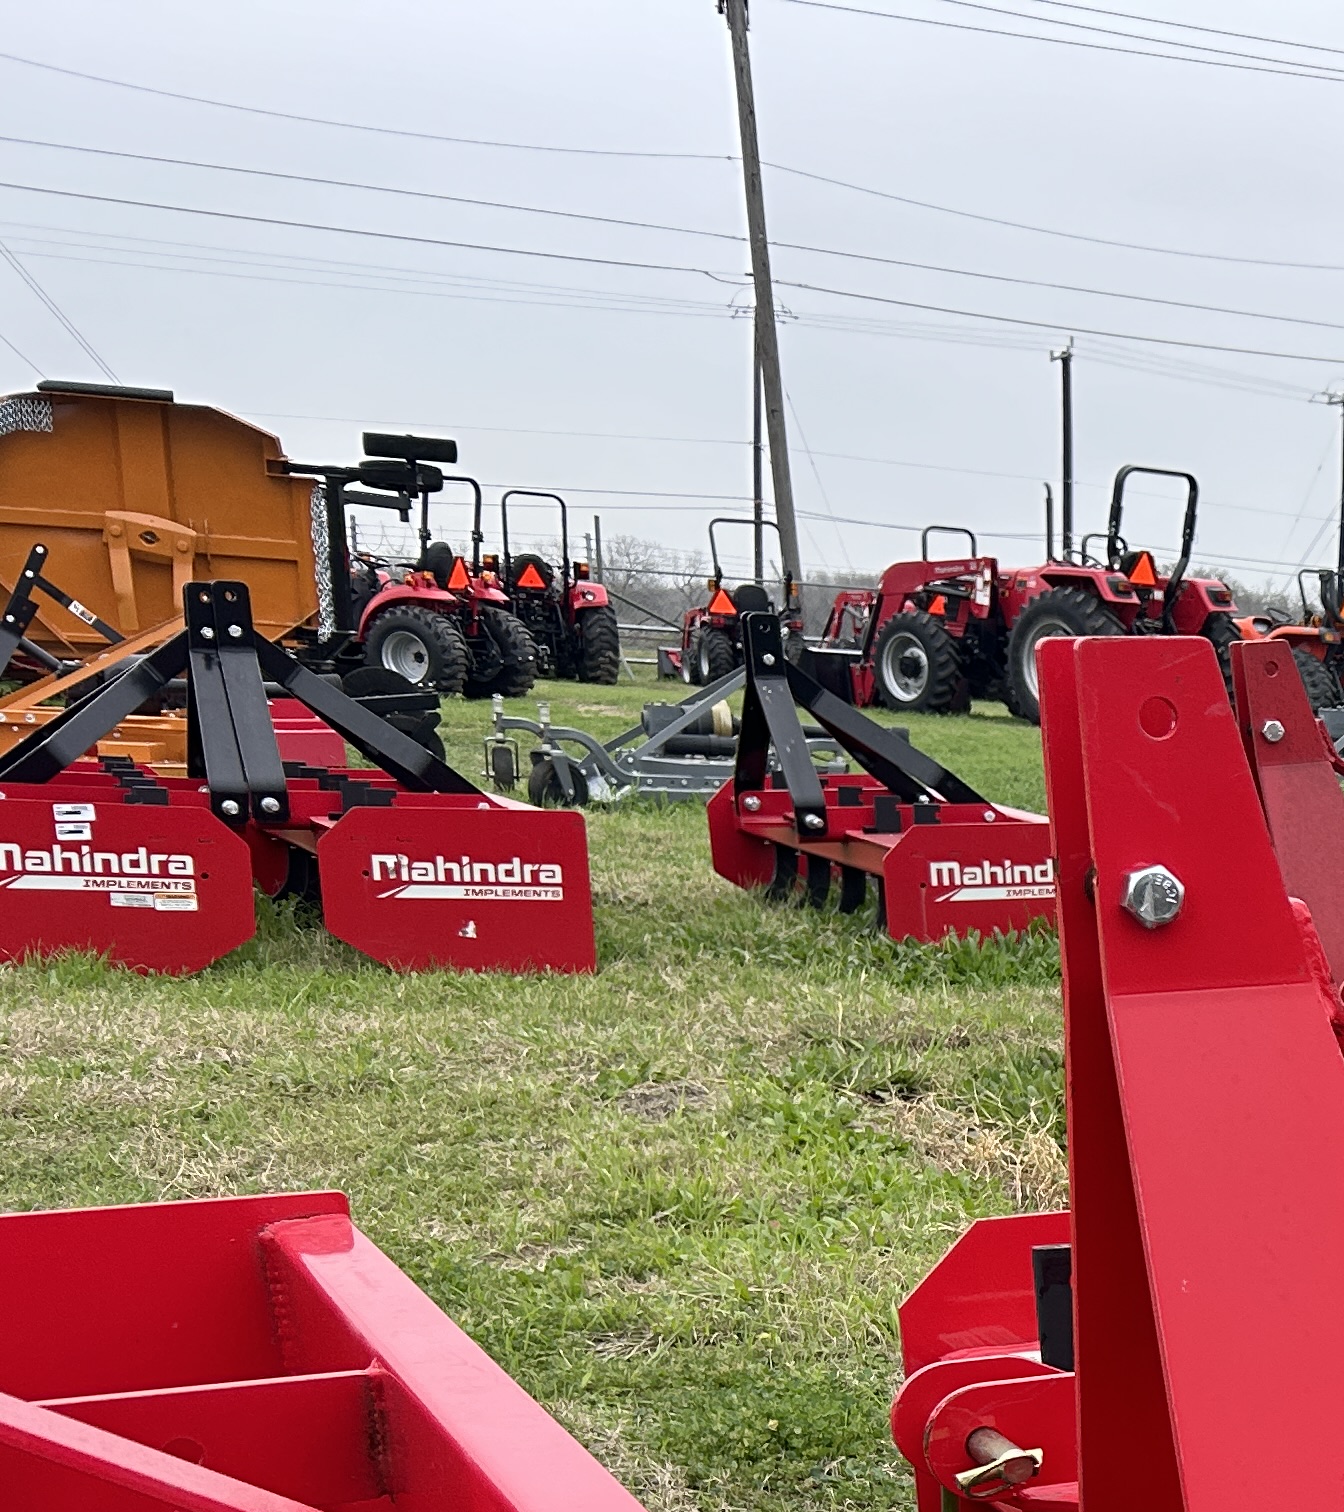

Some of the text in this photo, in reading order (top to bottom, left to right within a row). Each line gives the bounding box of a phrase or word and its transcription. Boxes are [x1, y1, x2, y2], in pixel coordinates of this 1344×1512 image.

[371, 853, 563, 884] Mahindra
[929, 858, 1054, 887] Mahind
[83, 878, 193, 891] IMPLEMENTS
[463, 887, 561, 899] IMPLEMENTS
[1005, 888, 1056, 897] IMPLEM
